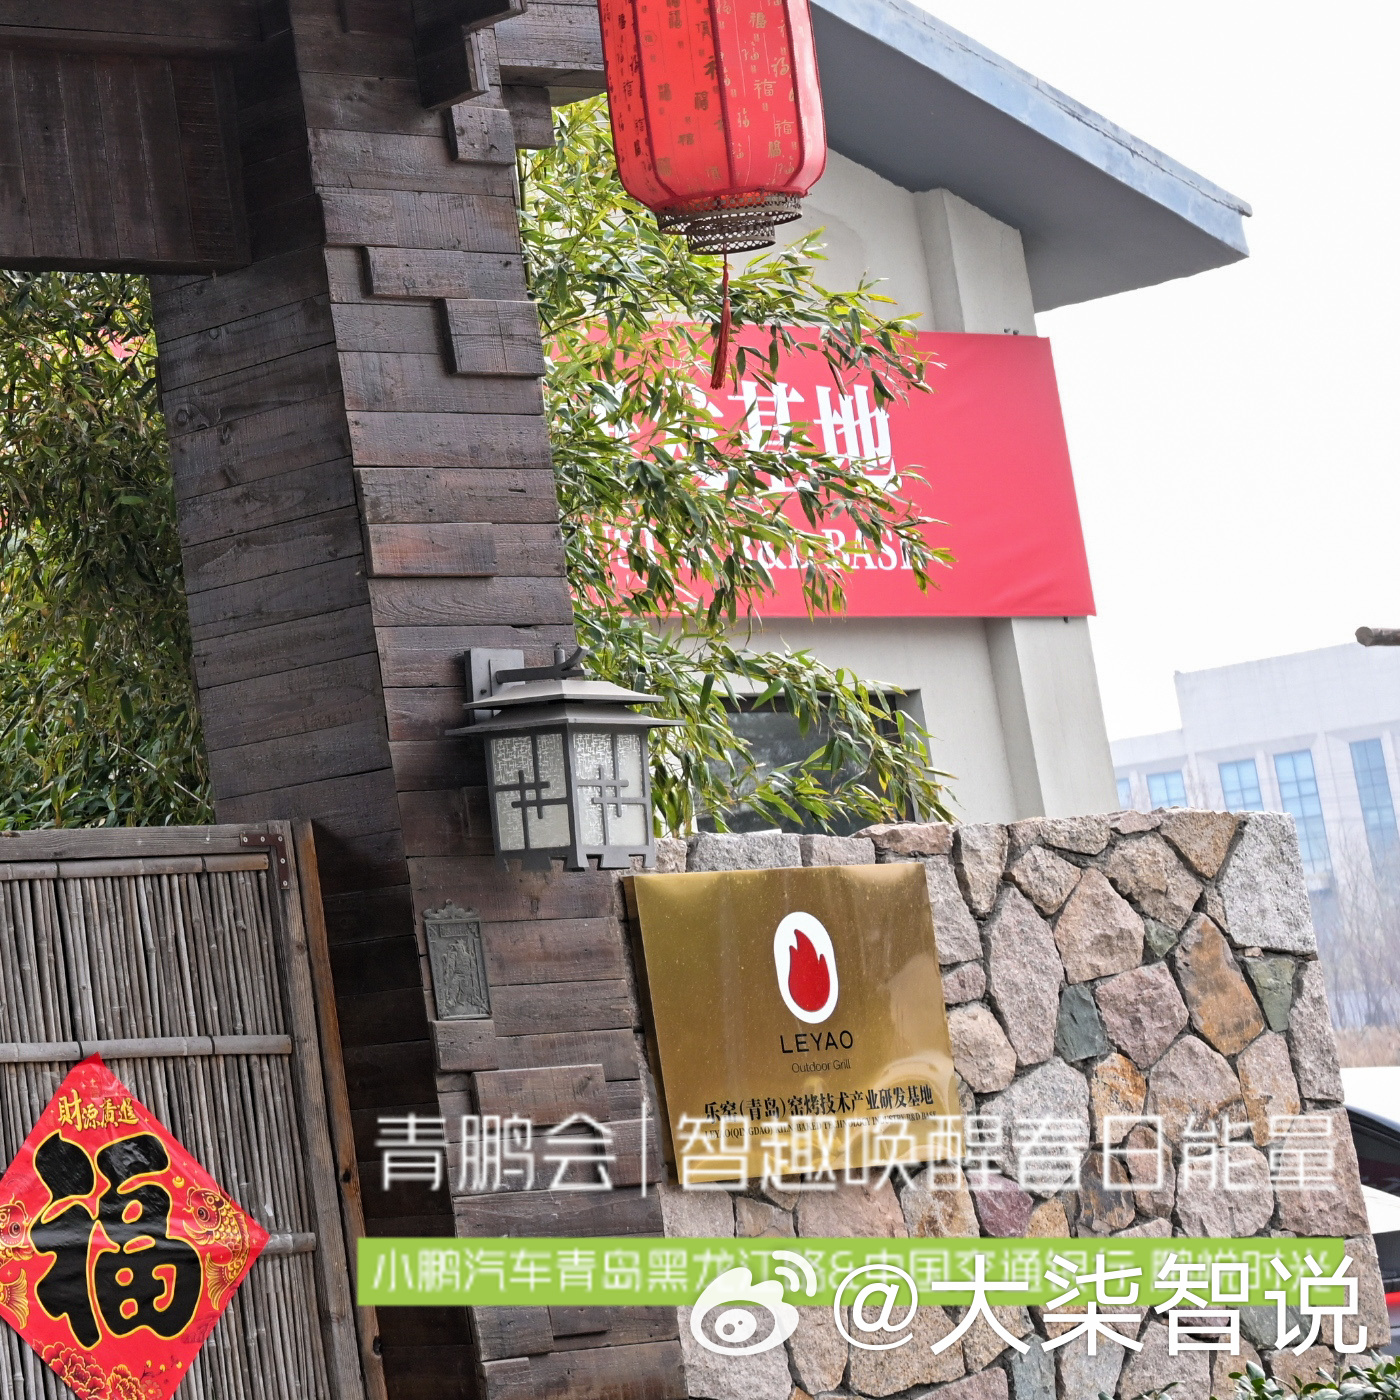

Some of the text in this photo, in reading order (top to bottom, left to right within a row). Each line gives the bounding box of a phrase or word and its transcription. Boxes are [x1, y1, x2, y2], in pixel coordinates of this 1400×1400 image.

[780, 1029, 854, 1054] LEYAO
[791, 1059, 852, 1074] Outdoor Grill
[29, 1129, 203, 1351] 福
